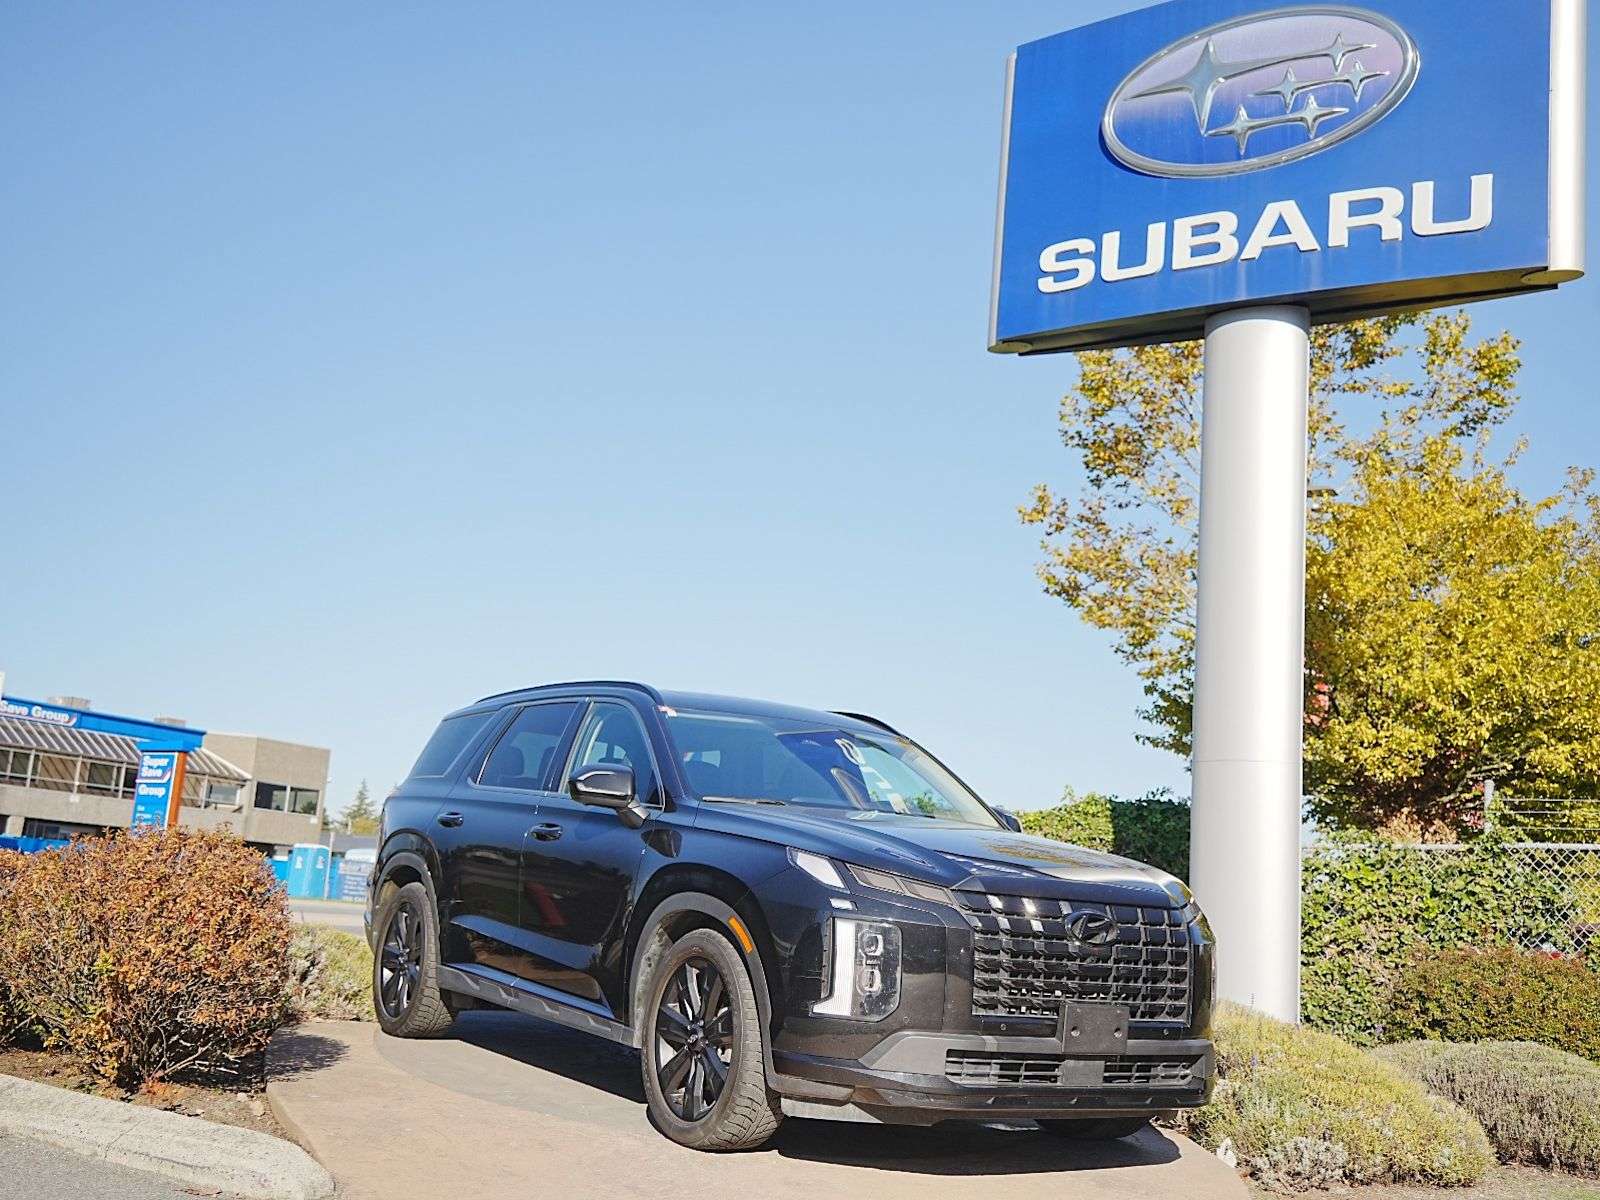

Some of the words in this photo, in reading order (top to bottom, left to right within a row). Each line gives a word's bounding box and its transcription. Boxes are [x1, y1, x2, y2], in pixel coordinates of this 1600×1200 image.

[1038, 173, 1493, 293] SUBARU
[31, 705, 69, 721] Group
[142, 755, 169, 768] Super
[141, 766, 163, 777] Save
[138, 783, 166, 798] Group
